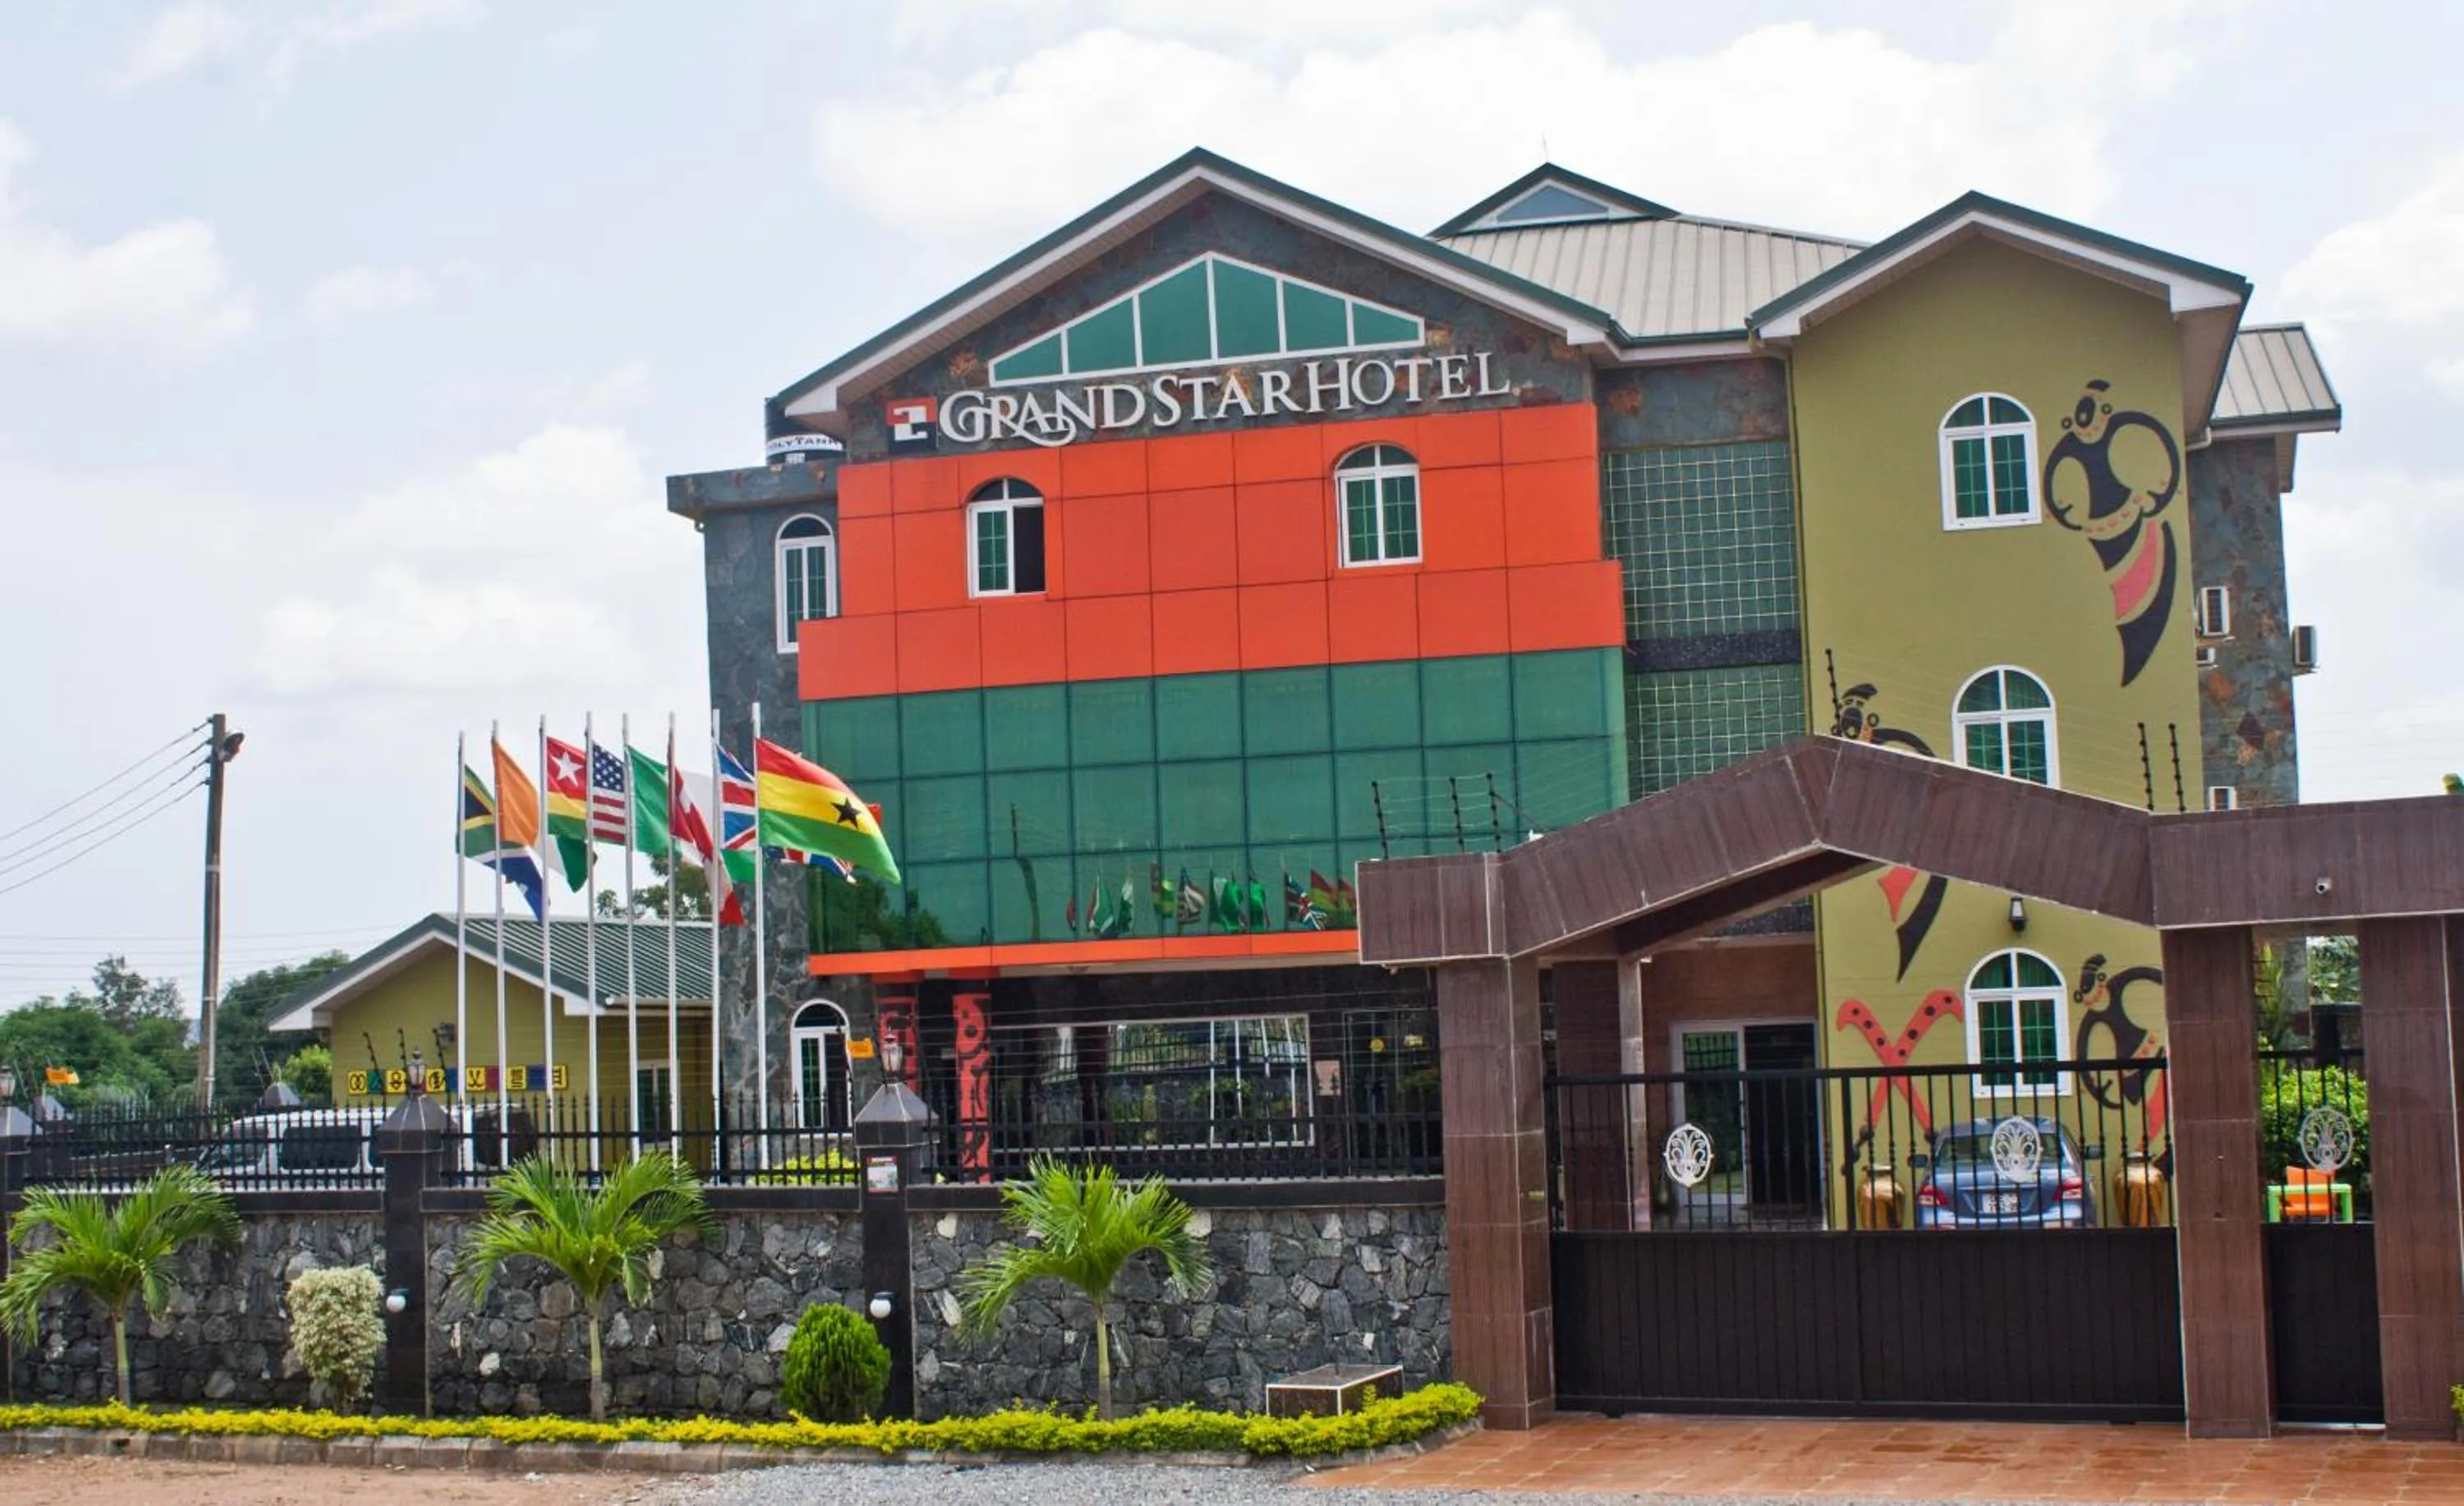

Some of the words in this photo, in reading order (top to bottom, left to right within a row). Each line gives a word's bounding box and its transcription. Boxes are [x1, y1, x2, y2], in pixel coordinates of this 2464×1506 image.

[938, 383, 1147, 447] GRAND
[1152, 370, 1303, 427] STAR
[1303, 352, 1510, 413] HOTEL
